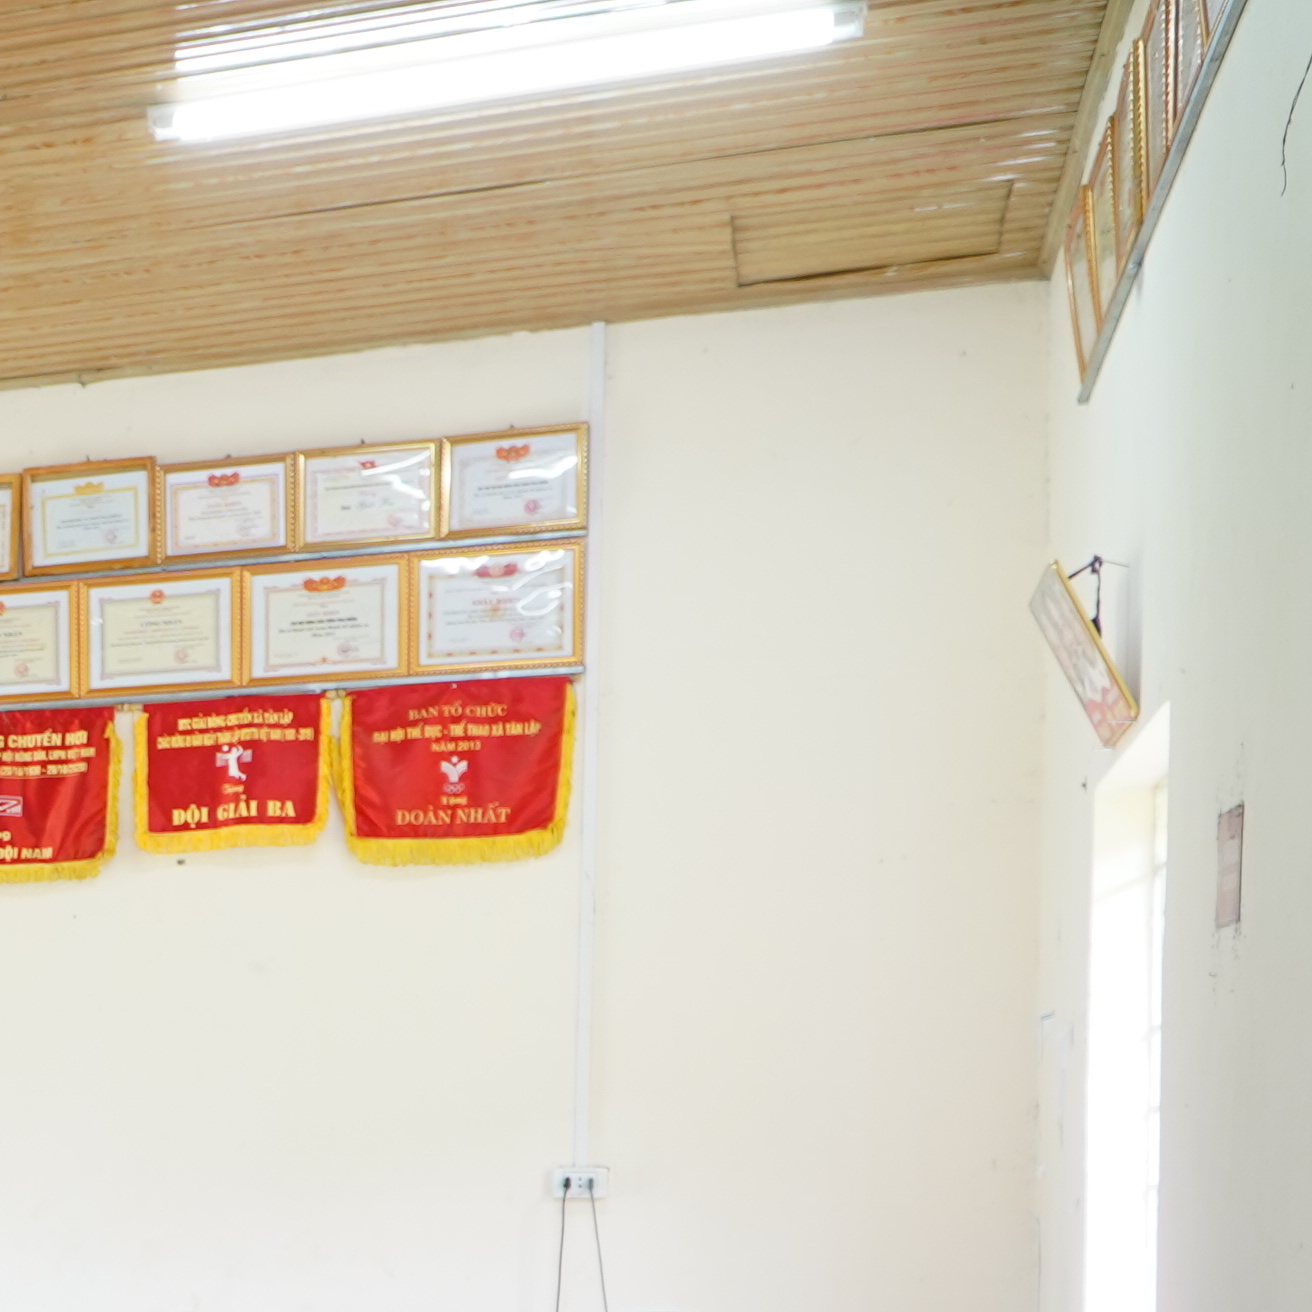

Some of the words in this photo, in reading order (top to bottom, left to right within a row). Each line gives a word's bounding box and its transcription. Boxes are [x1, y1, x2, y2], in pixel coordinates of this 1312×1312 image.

[409, 706, 438, 720] BAN
[443, 700, 463, 717] TỔ
[466, 702, 507, 717] CHỨC
[66, 731, 88, 745] HƠI
[432, 740, 456, 752] NĂM
[172, 803, 209, 828] ĐỘI
[217, 795, 258, 821] GIẢI
[267, 800, 296, 817] BA
[396, 805, 452, 826] ĐOÀN
[456, 801, 511, 824] NHẤT
[21, 847, 53, 859] NAM
